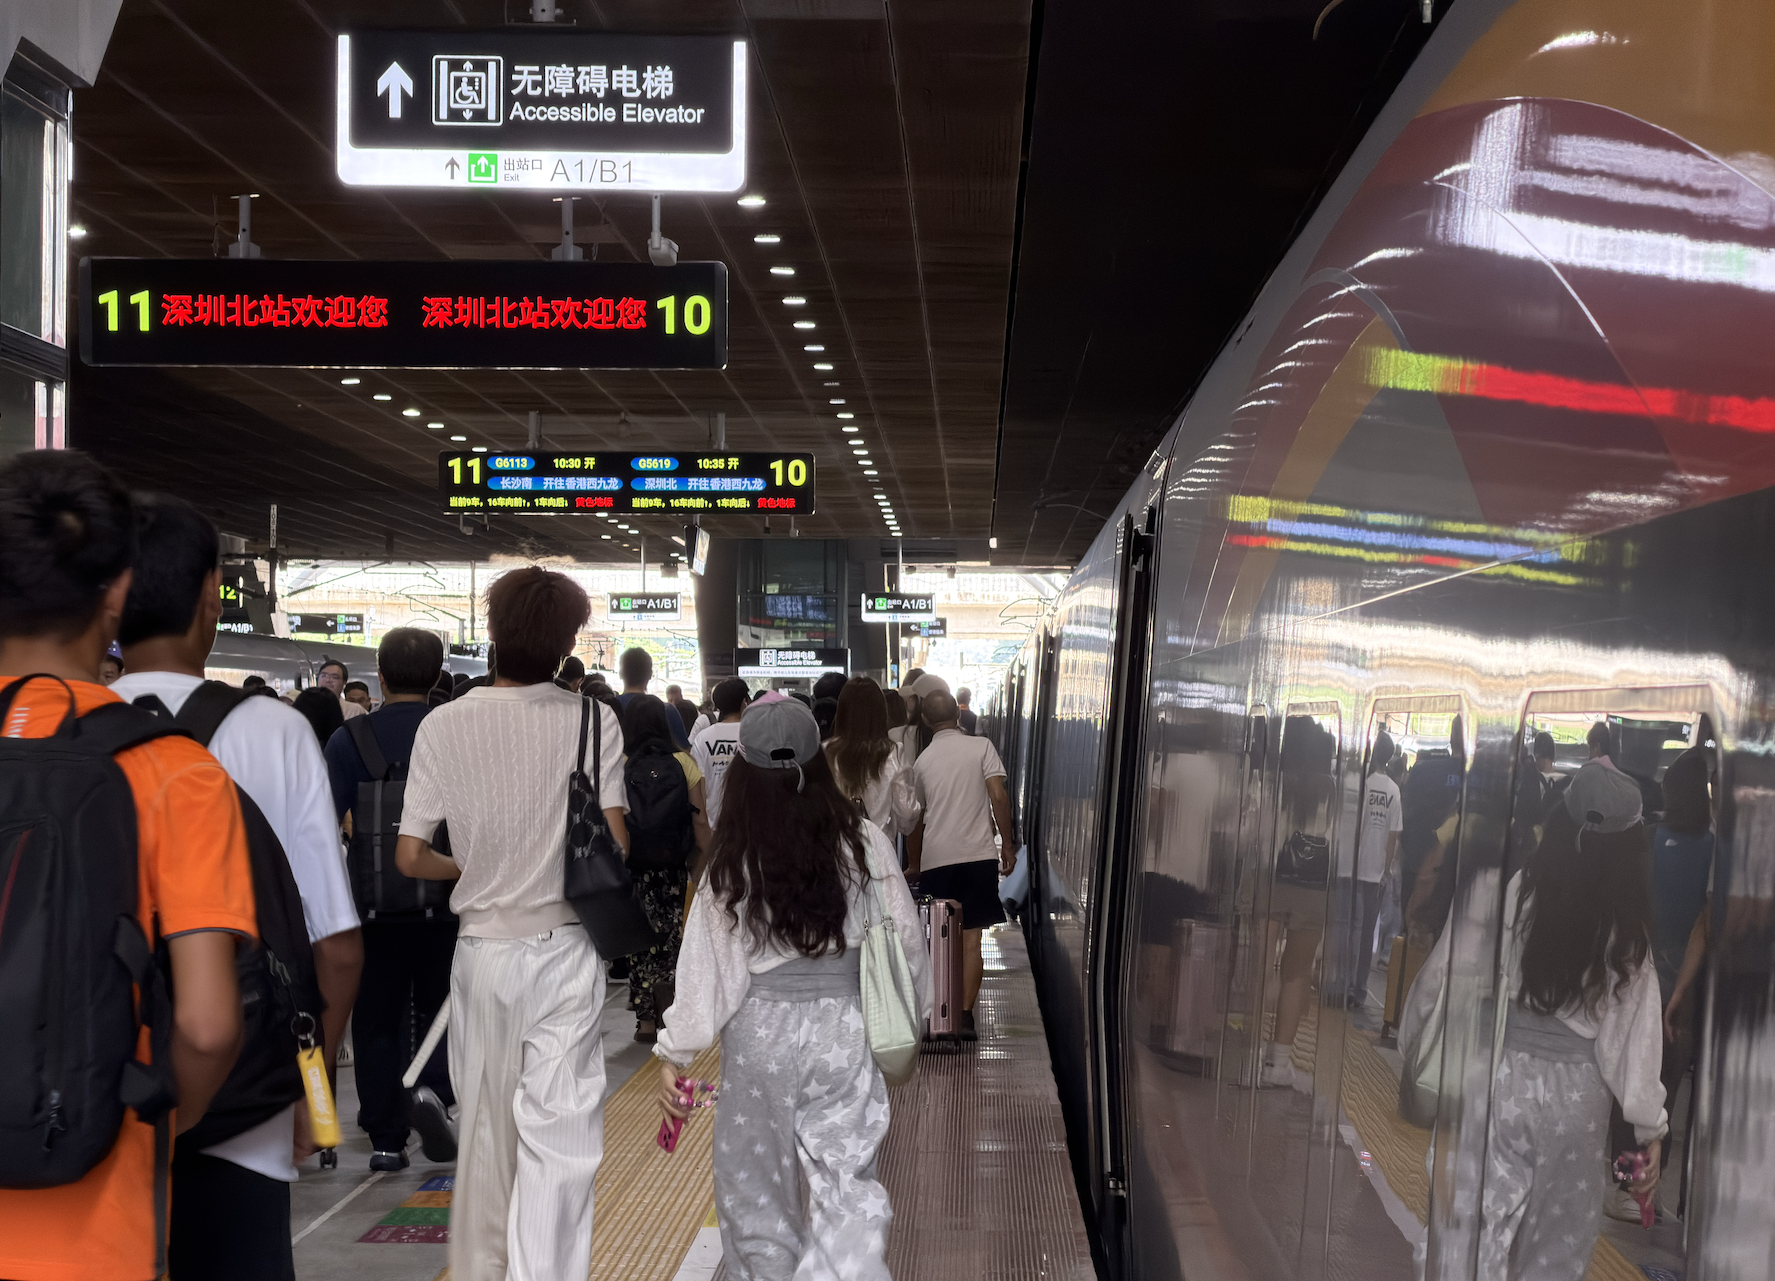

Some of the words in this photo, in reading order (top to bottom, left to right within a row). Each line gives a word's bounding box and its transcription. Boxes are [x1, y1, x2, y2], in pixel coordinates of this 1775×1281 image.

[511, 65, 674, 99] 无障碍电梯
[509, 101, 616, 122] Accessible
[623, 104, 705, 124] Elevator
[503, 157, 543, 172] 出站口
[550, 158, 634, 184] A1/B1
[504, 173, 520, 182] Exit
[98, 290, 151, 331] 11
[162, 294, 389, 329] 深圳北站欢迎您
[421, 296, 648, 330] 深圳北站欢迎您
[656, 295, 712, 336] 10
[495, 458, 528, 468] G6113
[553, 458, 581, 469] 10:30
[584, 457, 596, 470] 开
[638, 459, 671, 469] G5619
[697, 459, 725, 469] 10:35
[727, 458, 739, 470] 开
[448, 457, 481, 485] 11
[769, 459, 807, 487] 10
[500, 478, 533, 490] 长沙南
[543, 478, 619, 490] 开往香港西九龙
[645, 478, 678, 490] 深圳北
[688, 478, 763, 490] 开往香港西九龙
[647, 598, 677, 609] A1/B1
[902, 599, 932, 610] A1/B1
[705, 739, 738, 756] VAN
